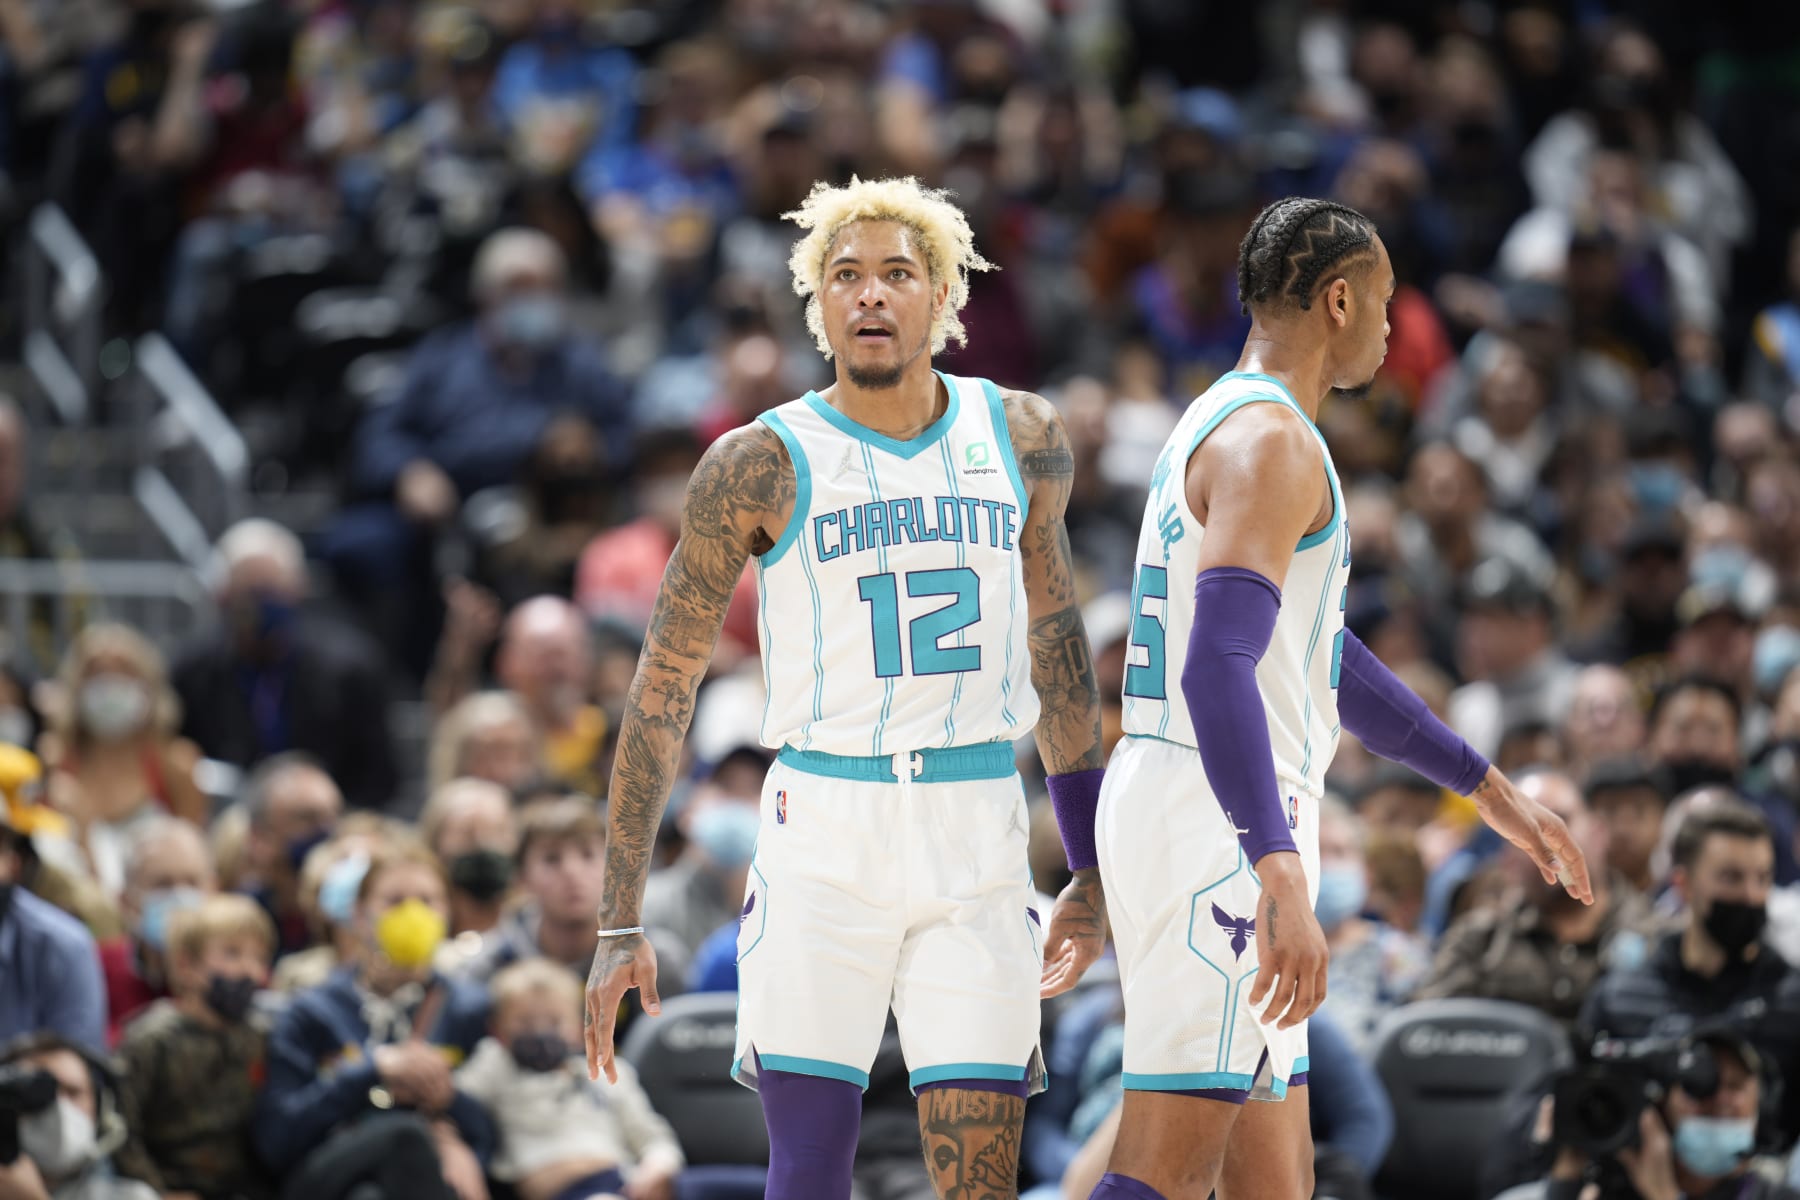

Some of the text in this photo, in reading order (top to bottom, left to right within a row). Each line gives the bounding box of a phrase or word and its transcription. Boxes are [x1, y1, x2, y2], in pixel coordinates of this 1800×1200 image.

[962, 467, 998, 476] lendingtree
[813, 495, 1017, 563] CHARLOTTE
[1157, 502, 1185, 562] JR.
[857, 566, 982, 679] 12
[1124, 562, 1168, 700] 5
